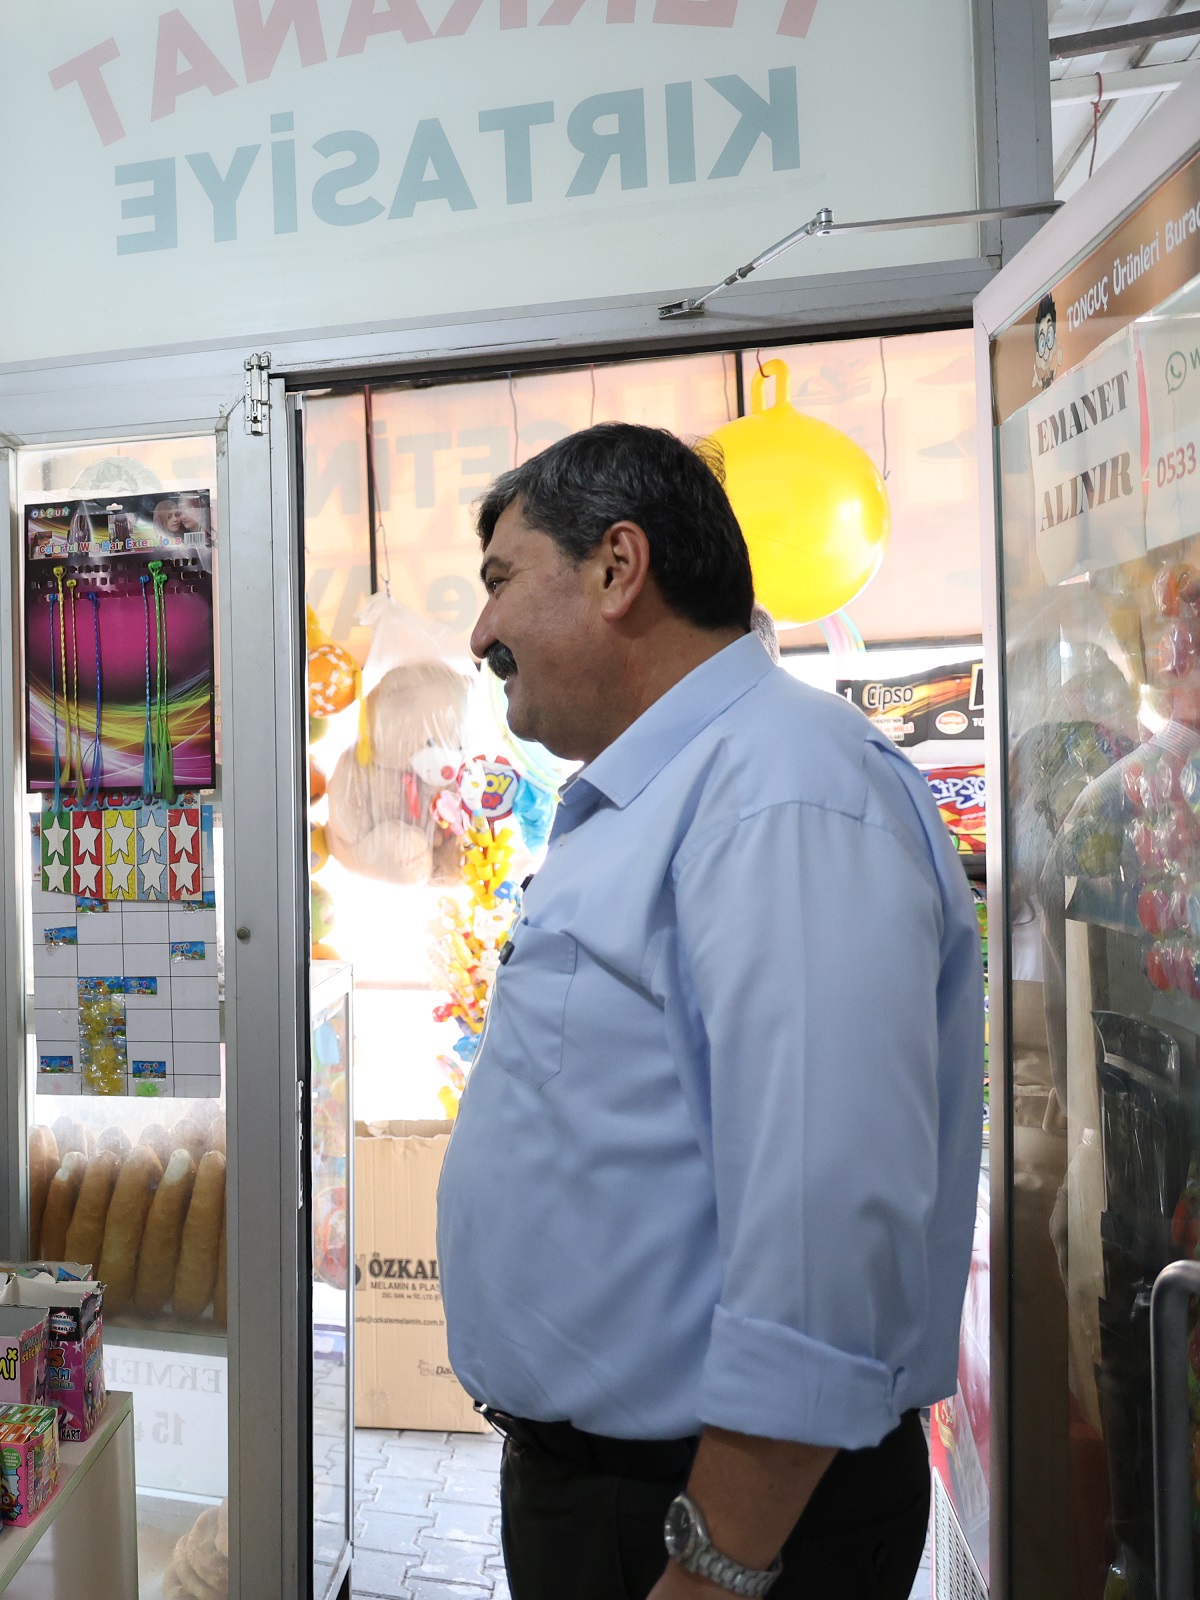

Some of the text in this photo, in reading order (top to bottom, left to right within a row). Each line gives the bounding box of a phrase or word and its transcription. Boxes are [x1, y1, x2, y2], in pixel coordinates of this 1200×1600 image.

[1066, 275, 1109, 334] TONGUÇ
[1113, 231, 1160, 296] Ürünleri
[1035, 369, 1129, 456] EMANET
[1157, 442, 1197, 488] 0533
[1040, 451, 1133, 532] ALINIR
[39, 541, 78, 555] Colorful
[102, 539, 124, 551] Hair
[368, 1252, 439, 1280] ÖZKAL
[370, 1281, 441, 1292] MELAMİN & PLAS
[61, 1429, 81, 1440] KART
